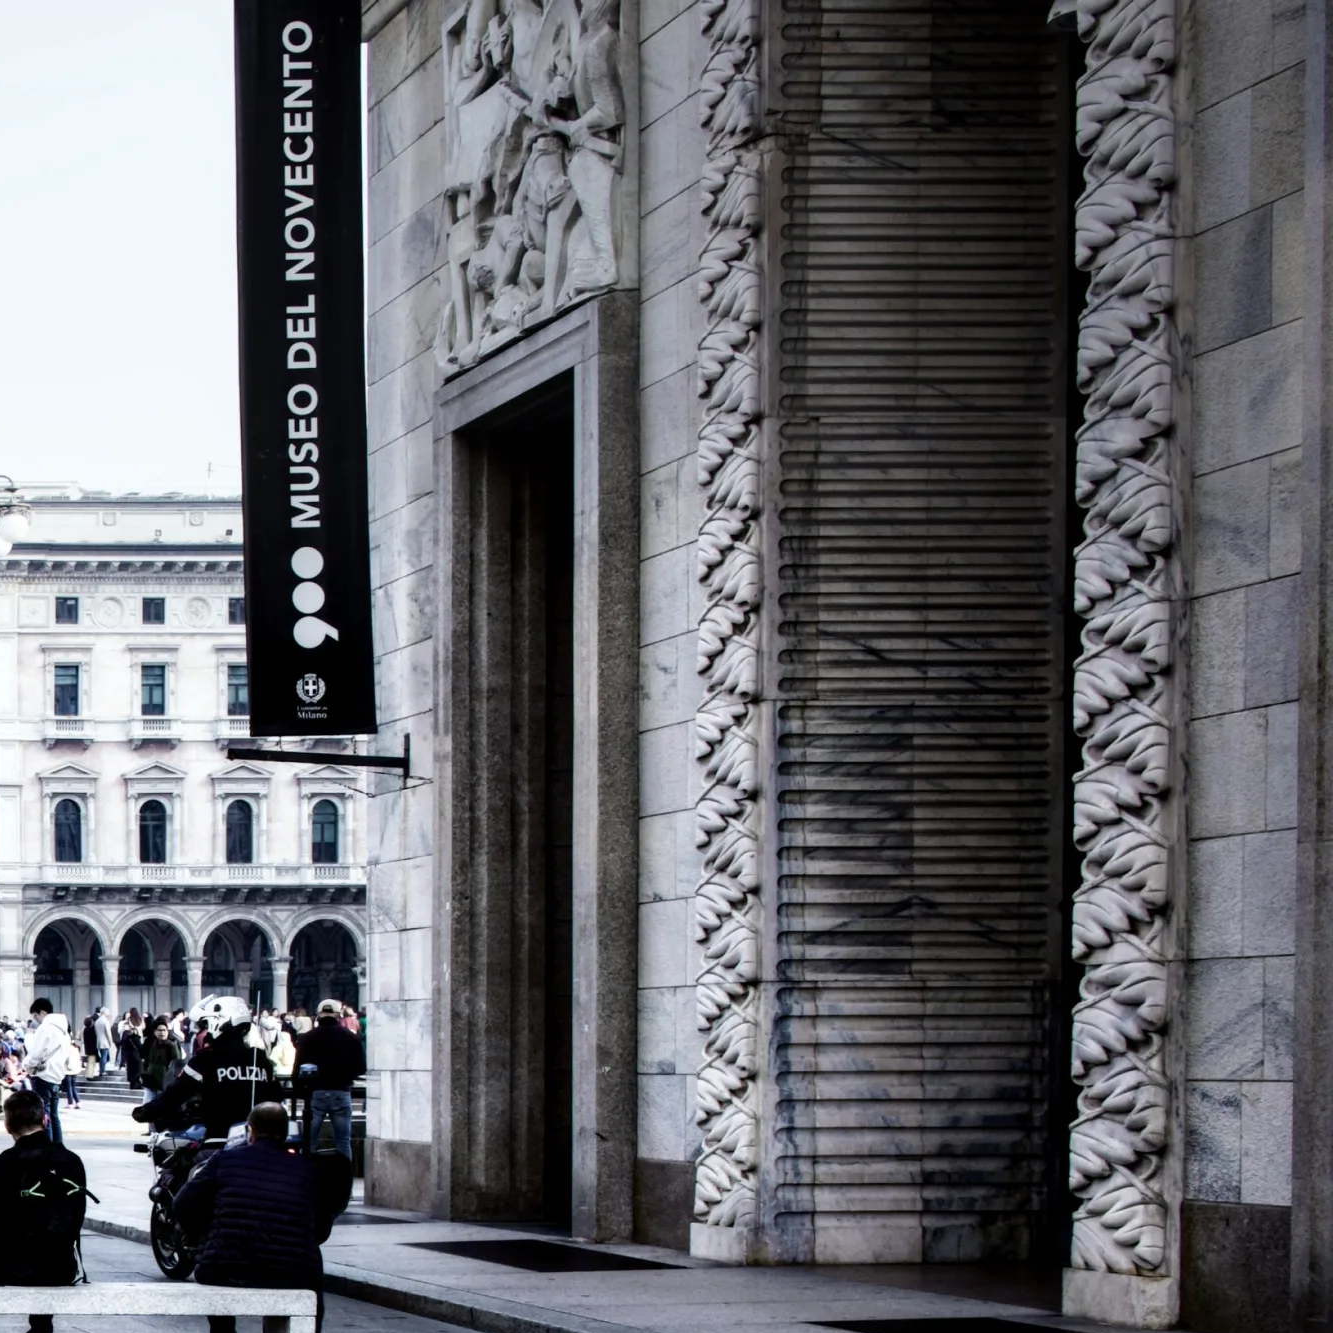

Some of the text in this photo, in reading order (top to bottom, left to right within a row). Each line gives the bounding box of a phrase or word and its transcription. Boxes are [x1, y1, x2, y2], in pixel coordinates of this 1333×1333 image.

[282, 20, 315, 281] NOVECENTO
[285, 294, 316, 368] DEL
[287, 383, 321, 528] MUSEO
[297, 711, 328, 719] Milano
[217, 1066, 268, 1082] POLIZIA
